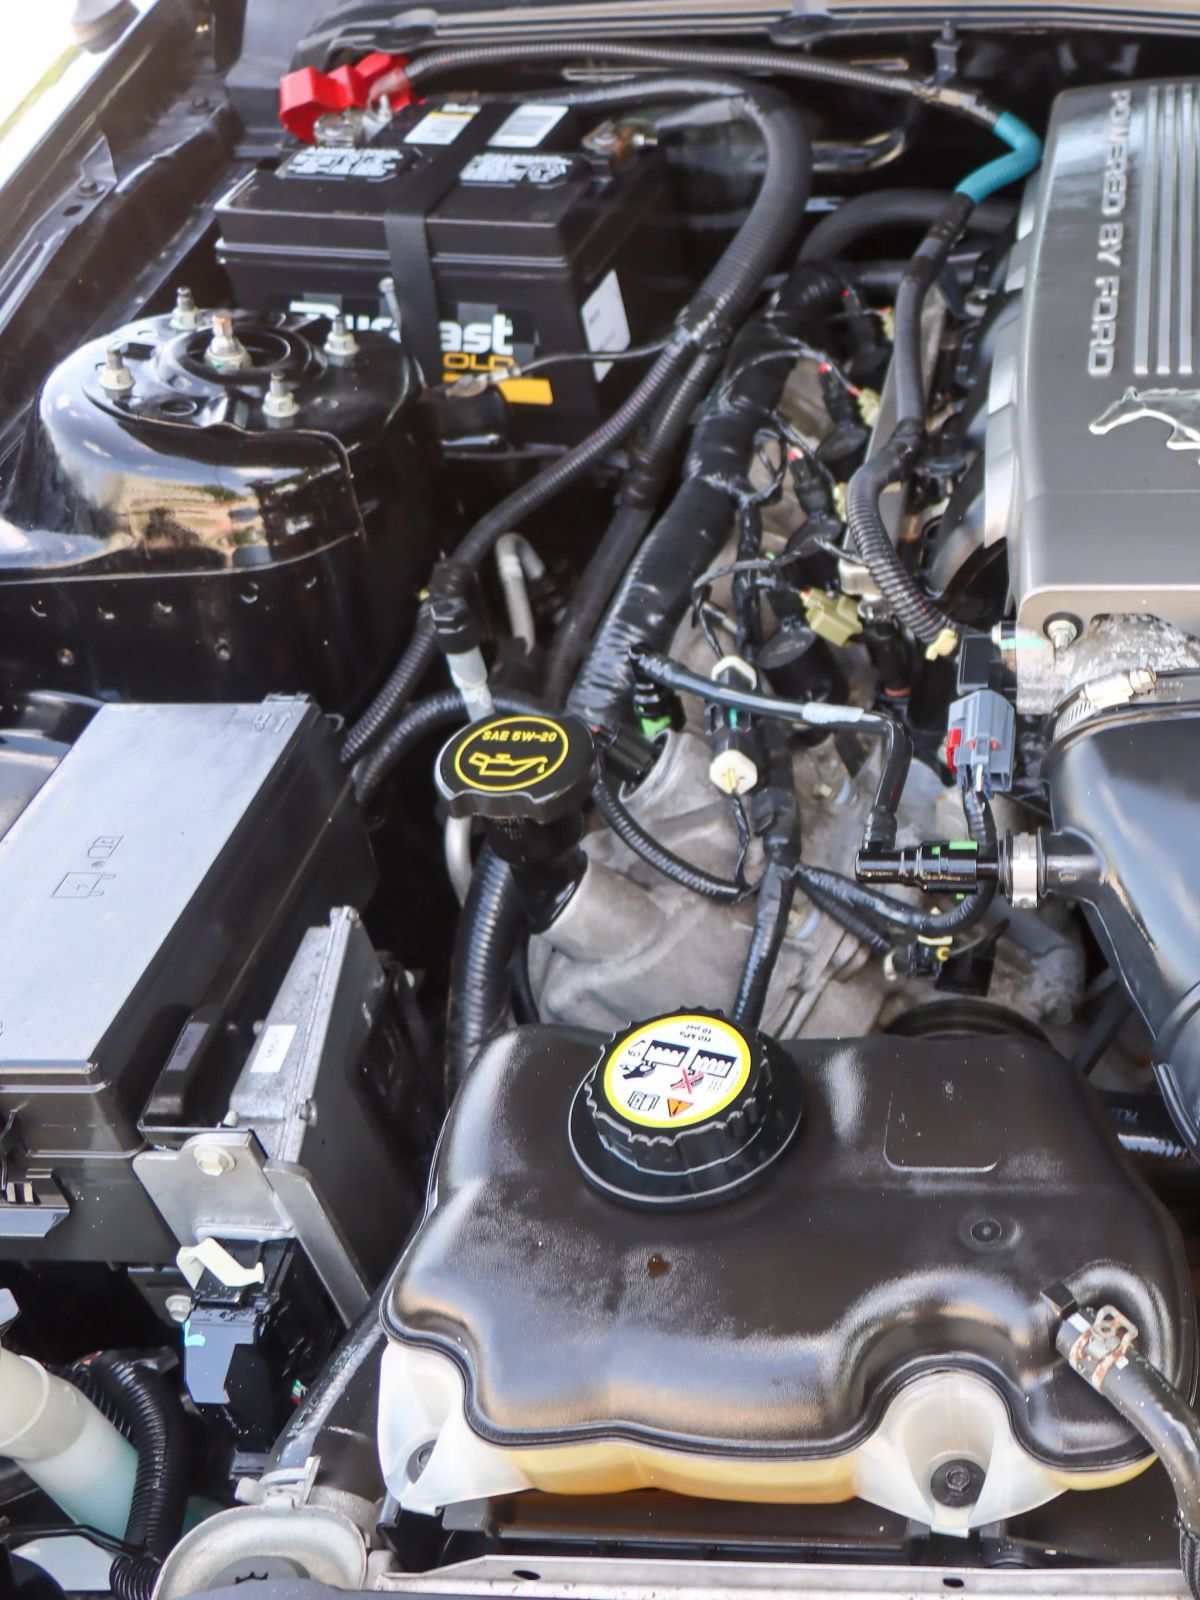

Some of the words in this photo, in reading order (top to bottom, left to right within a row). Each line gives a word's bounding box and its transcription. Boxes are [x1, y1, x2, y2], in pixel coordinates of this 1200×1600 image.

[1102, 89, 1131, 216] POWERED
[1097, 222, 1123, 267] BY
[1087, 275, 1120, 376] FORD
[482, 730, 510, 742] SAE
[511, 730, 558, 743] 5W-20
